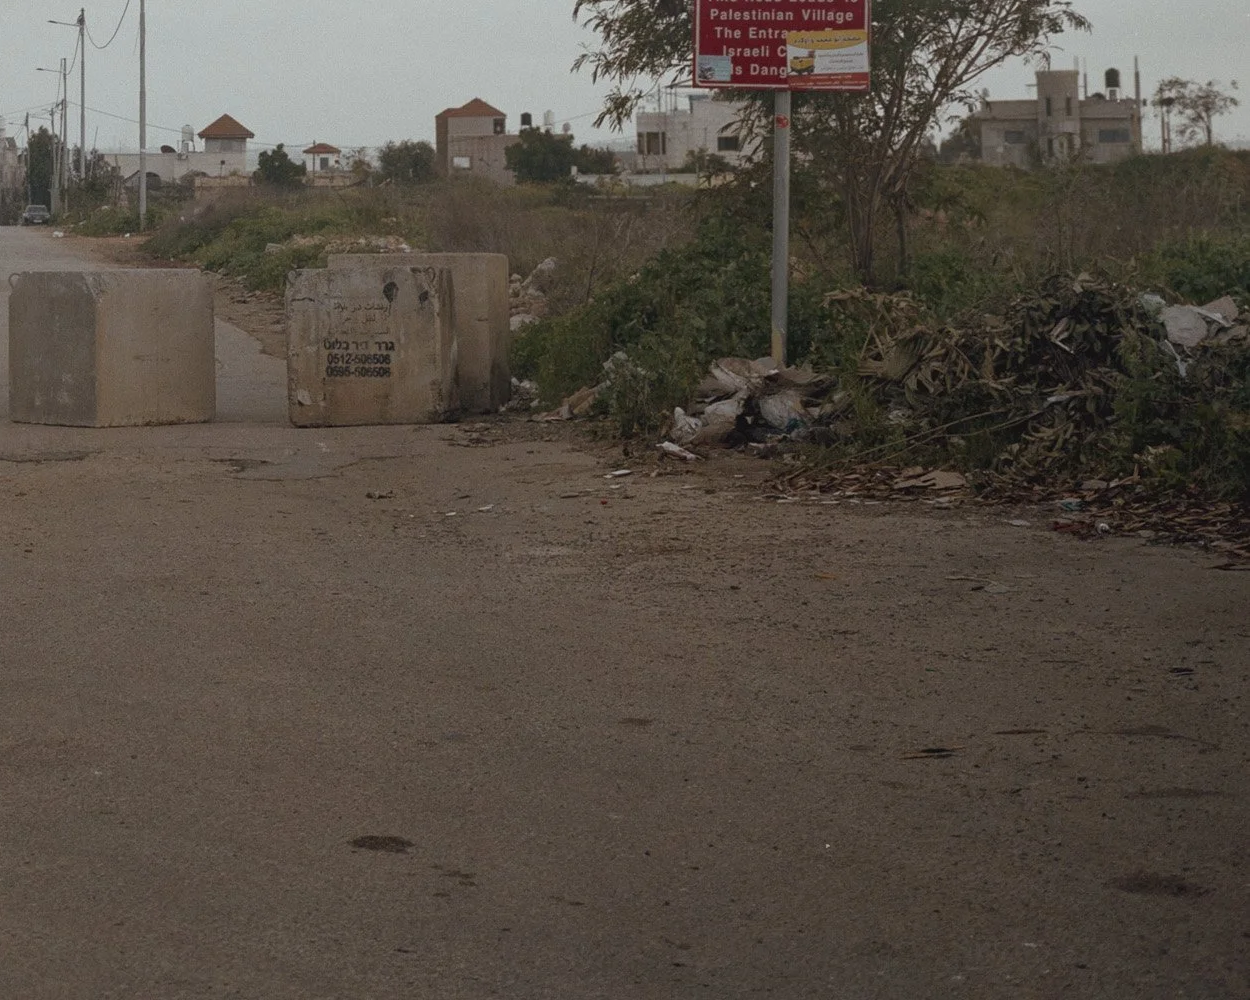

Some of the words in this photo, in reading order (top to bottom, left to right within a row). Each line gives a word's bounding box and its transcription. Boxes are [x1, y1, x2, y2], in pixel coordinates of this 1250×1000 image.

[710, 8, 794, 21] Palestinian
[801, 9, 854, 24] Village
[714, 27, 742, 39] The
[749, 27, 804, 39] Entra
[722, 46, 770, 57] Israeli
